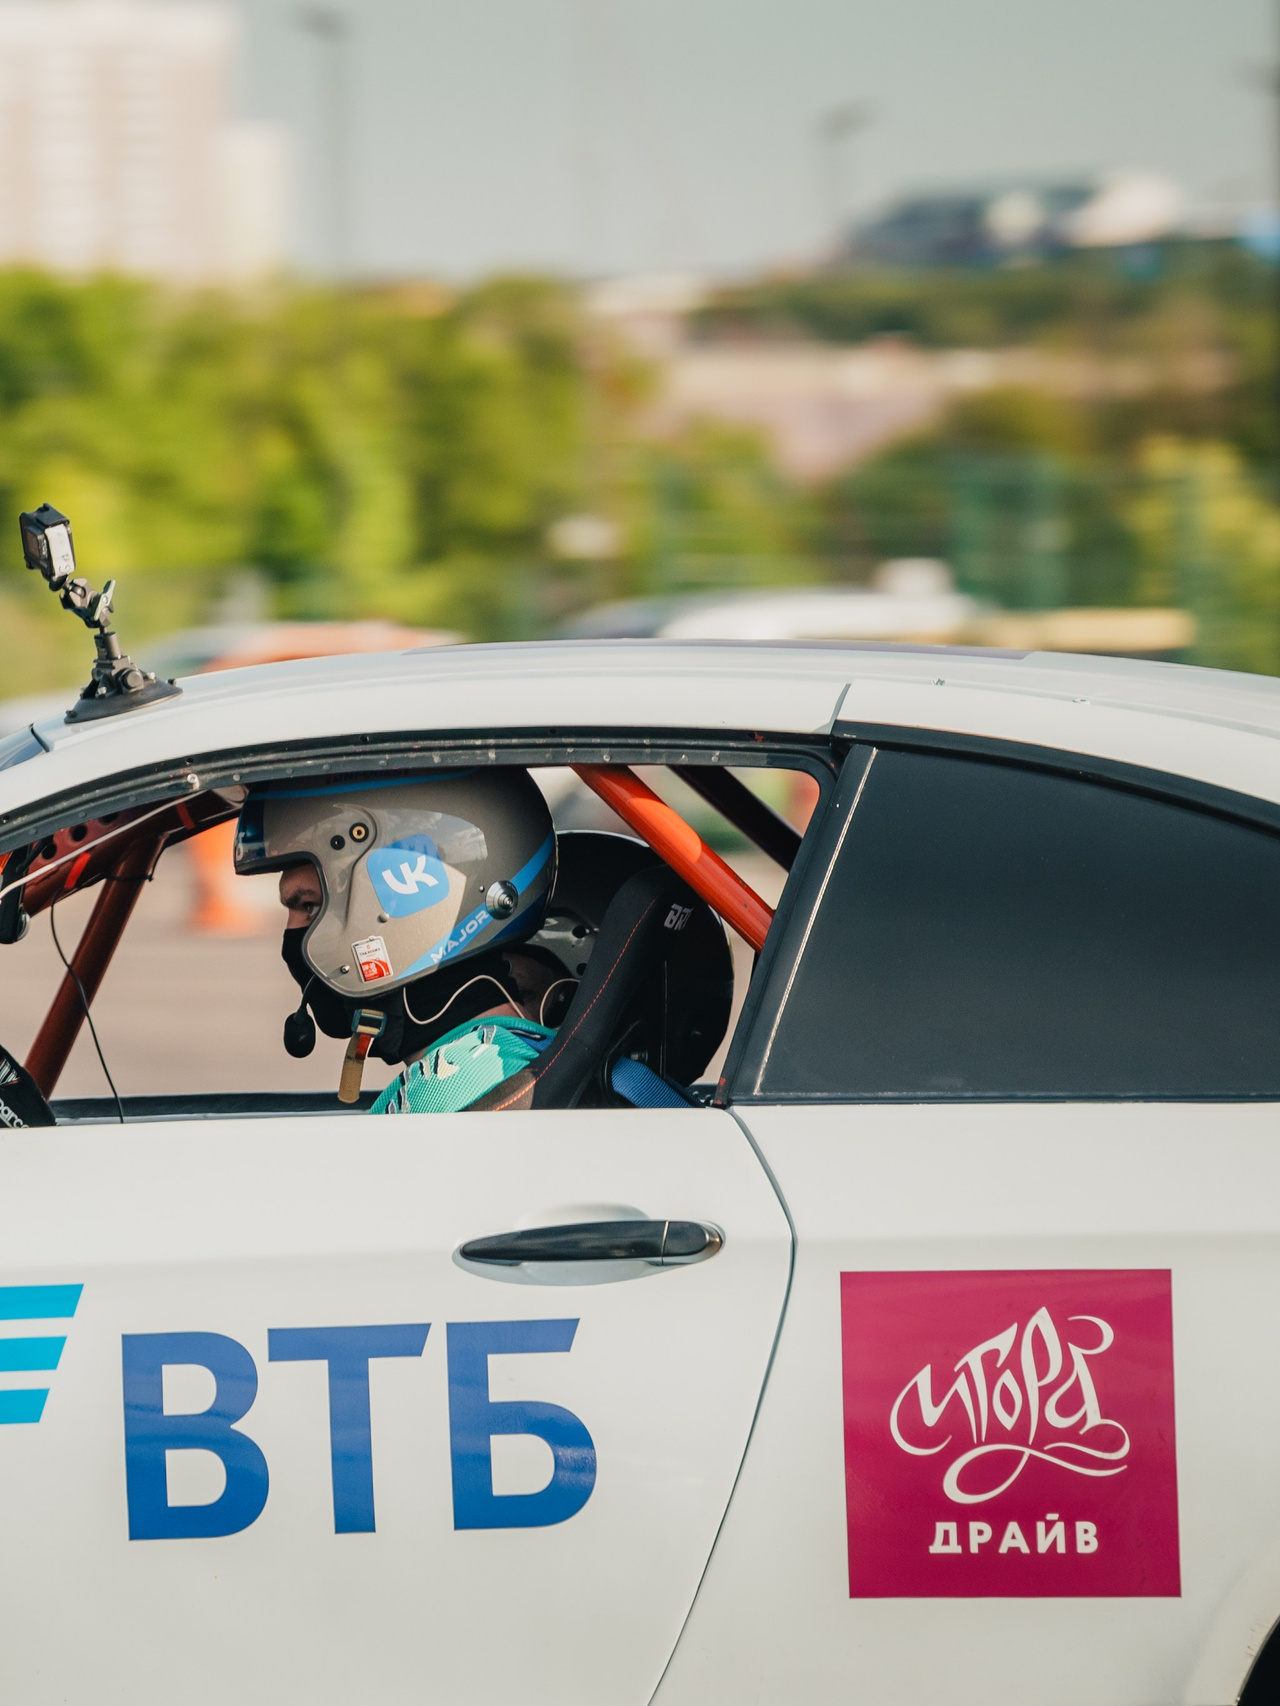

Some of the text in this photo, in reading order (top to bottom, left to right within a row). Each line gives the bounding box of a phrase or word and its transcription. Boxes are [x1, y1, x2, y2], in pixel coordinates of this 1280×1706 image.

[430, 909, 490, 964] MAJOR
[121, 1318, 597, 1542] ВТБ
[928, 1513, 1100, 1554] ДРАЙВ
